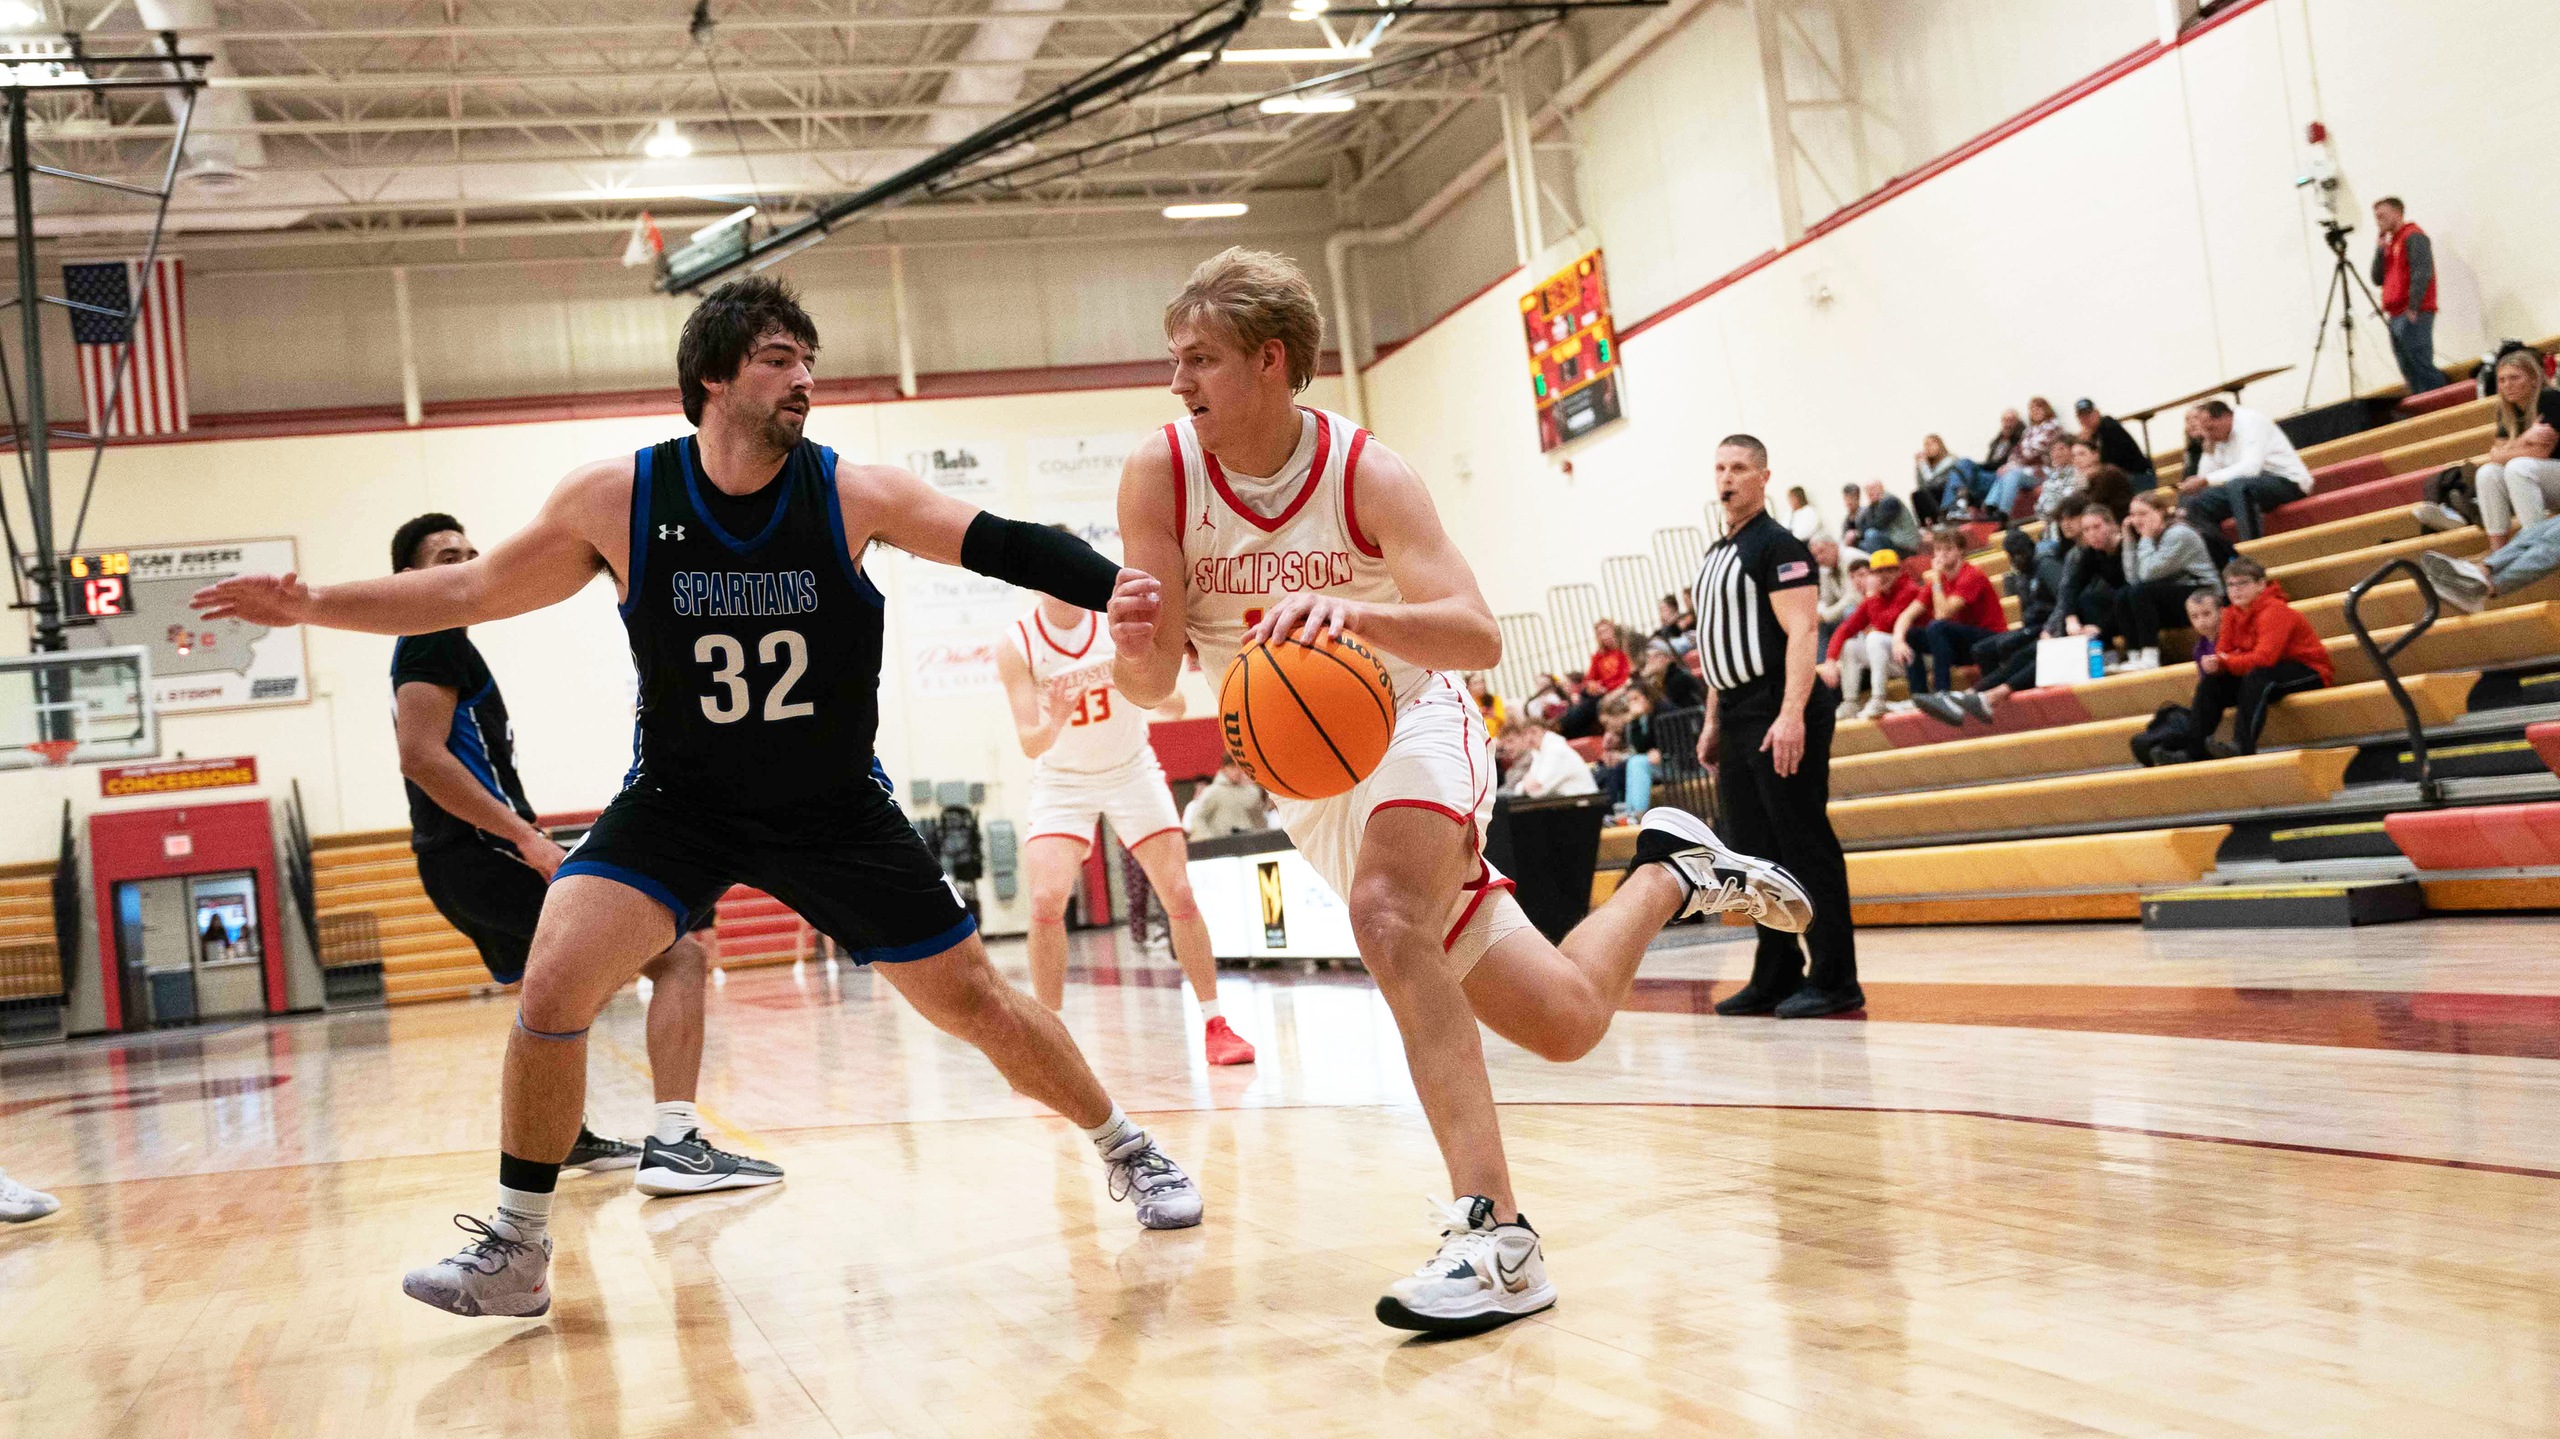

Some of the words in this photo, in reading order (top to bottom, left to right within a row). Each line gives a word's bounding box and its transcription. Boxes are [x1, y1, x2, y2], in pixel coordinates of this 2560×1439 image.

[672, 569, 818, 617] SPARTANS
[1195, 550, 1353, 594] SIMPSON
[84, 577, 123, 616] 12
[693, 629, 815, 725] 32
[107, 767, 251, 796] CONCESSIONS
